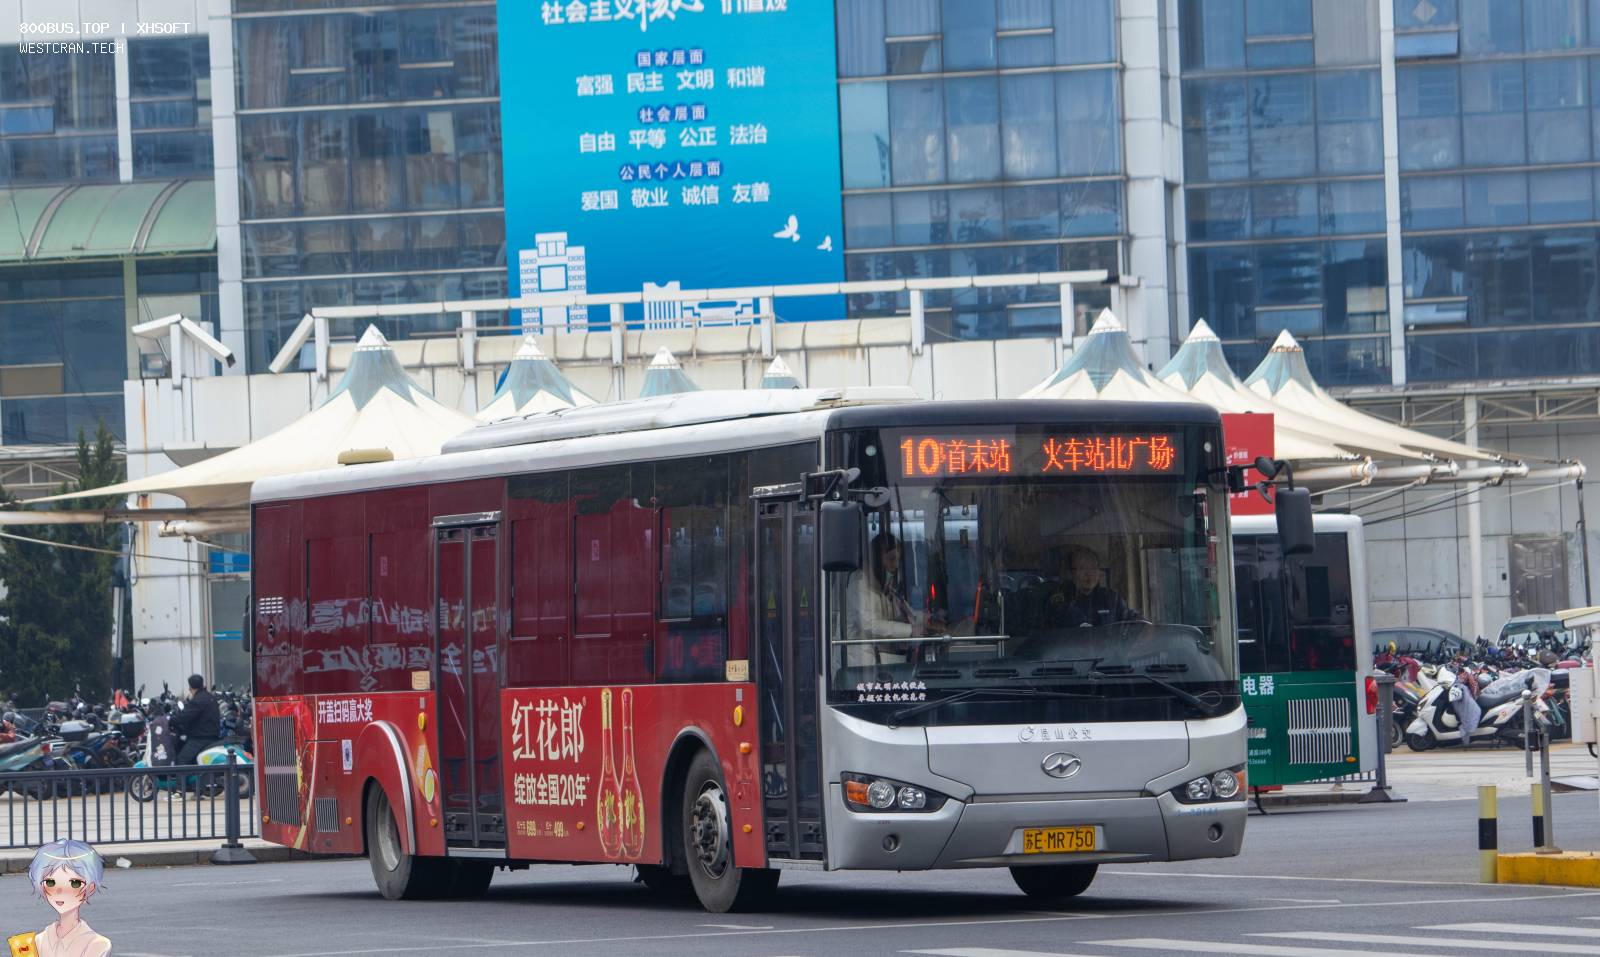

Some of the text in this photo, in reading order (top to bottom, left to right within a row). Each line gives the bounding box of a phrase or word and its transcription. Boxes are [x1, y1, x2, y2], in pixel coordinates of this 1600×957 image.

[637, 49, 703, 68] 国家层面
[576, 66, 765, 96] 富强 民主 文明 和谐
[639, 105, 706, 123] 社会层面
[579, 124, 767, 153] 自由 平等 公正 法治
[620, 161, 721, 181] 公民个人层面
[581, 182, 770, 211] 爱国 敬业 诚信 友善
[901, 438, 940, 474] 10
[1042, 436, 1172, 472] 火车站北广场
[1242, 675, 1275, 696] 电器
[318, 698, 373, 724] 开盖扫码赢大奖
[511, 696, 585, 763] 红花郎
